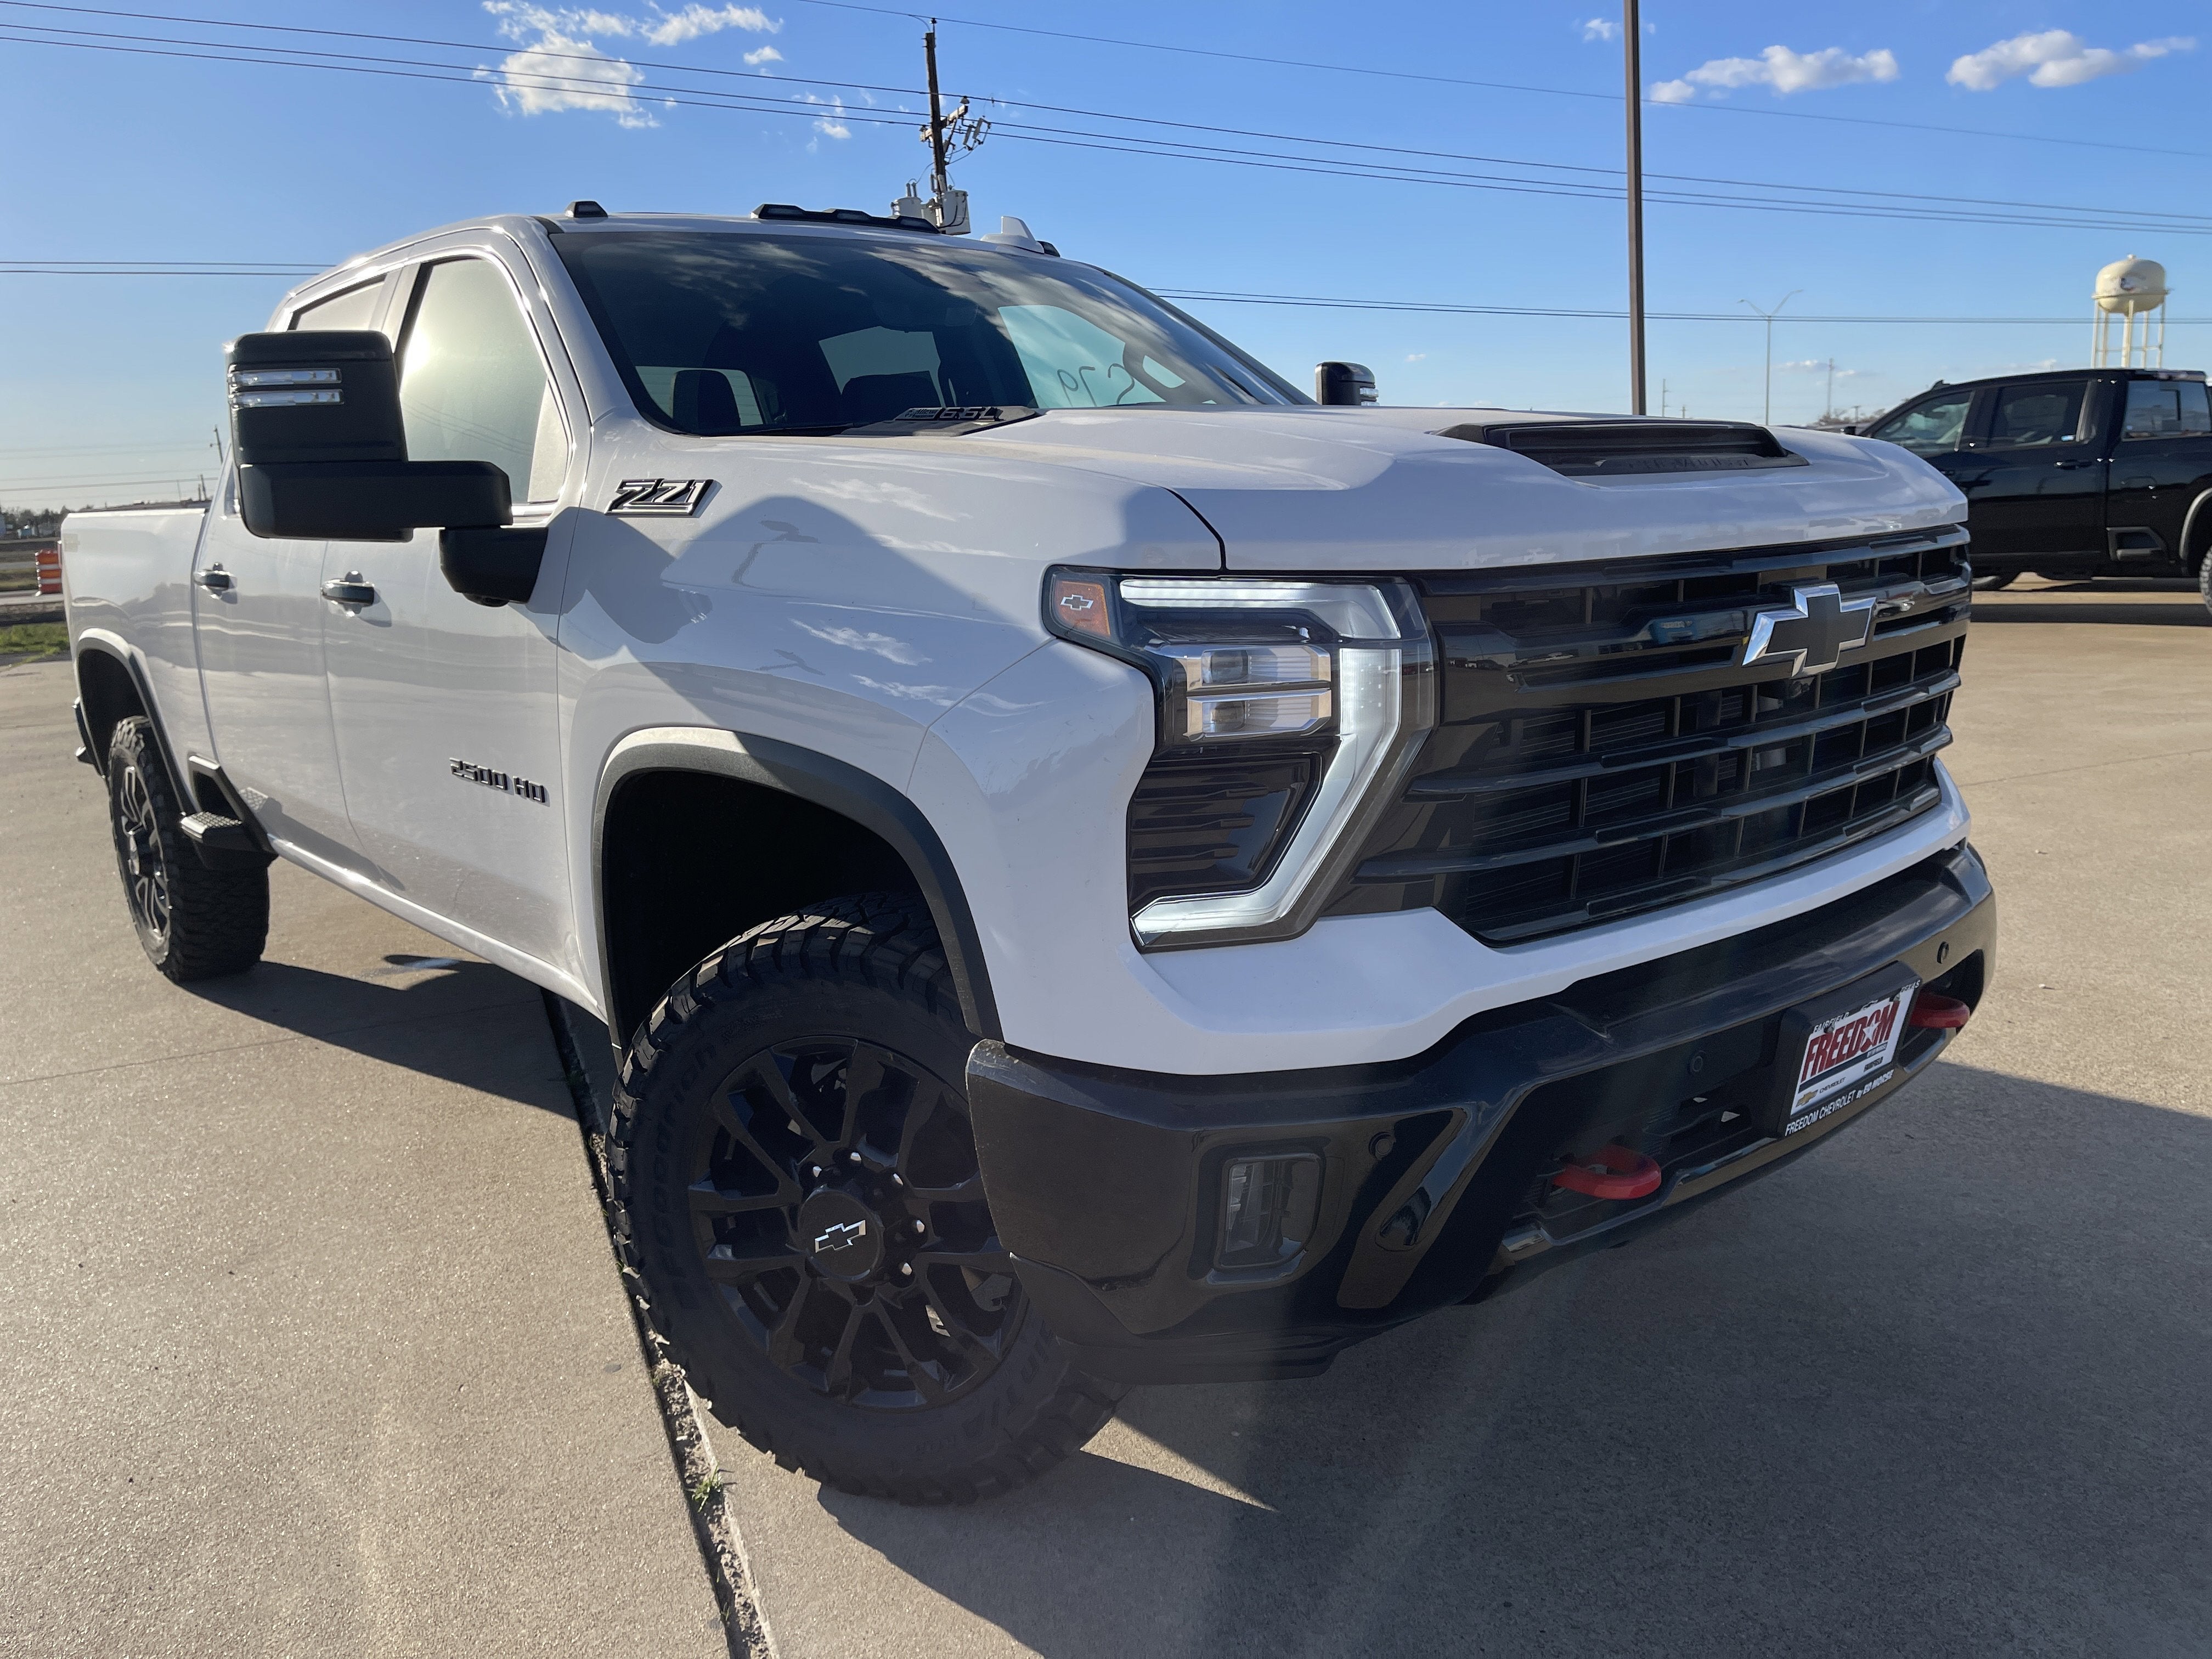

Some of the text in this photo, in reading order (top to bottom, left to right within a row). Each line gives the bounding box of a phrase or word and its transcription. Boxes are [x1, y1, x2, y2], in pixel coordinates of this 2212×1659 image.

[940, 407, 996, 421] 6.6L
[604, 478, 714, 516] Z71
[449, 757, 545, 803] 2500 HD
[1801, 1001, 1900, 1082] FREEDOM
[1785, 1110, 1819, 1136] FREEDOM
[1819, 1090, 1856, 1120] CHEVROLET
